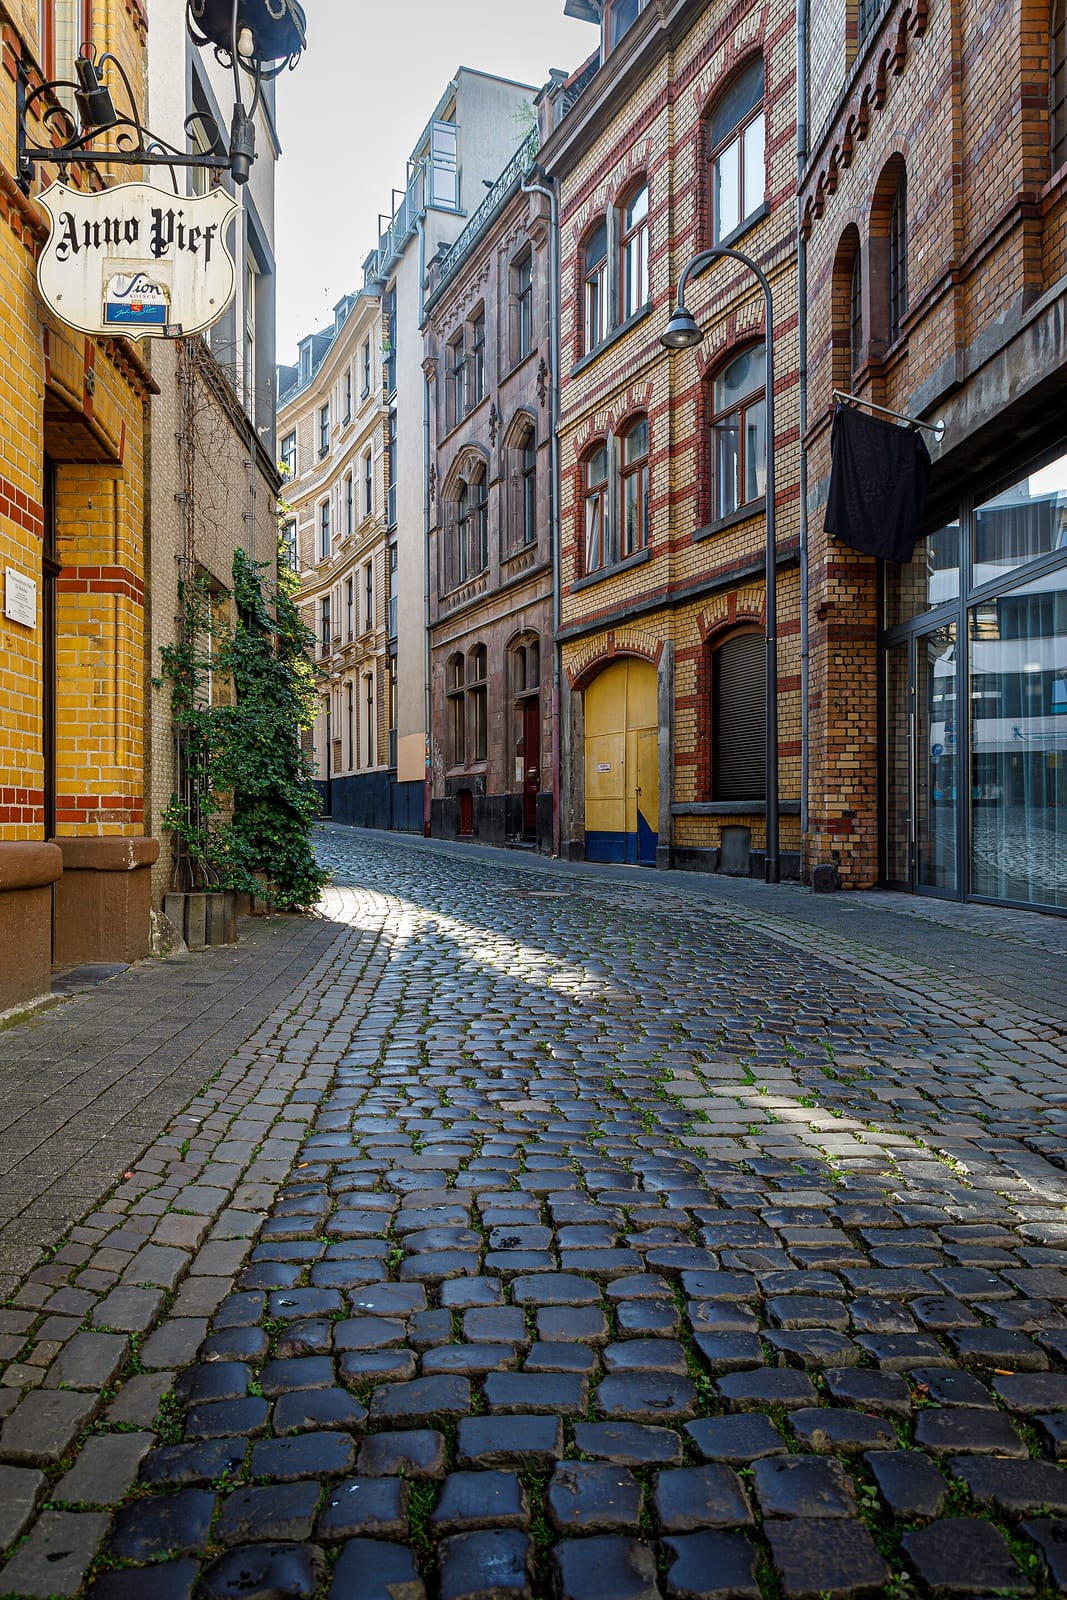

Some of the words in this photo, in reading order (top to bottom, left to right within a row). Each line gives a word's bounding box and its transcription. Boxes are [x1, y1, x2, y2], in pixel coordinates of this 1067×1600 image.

[55, 211, 140, 262] Anno
[149, 206, 218, 272] Pief
[112, 272, 162, 298] Sion
